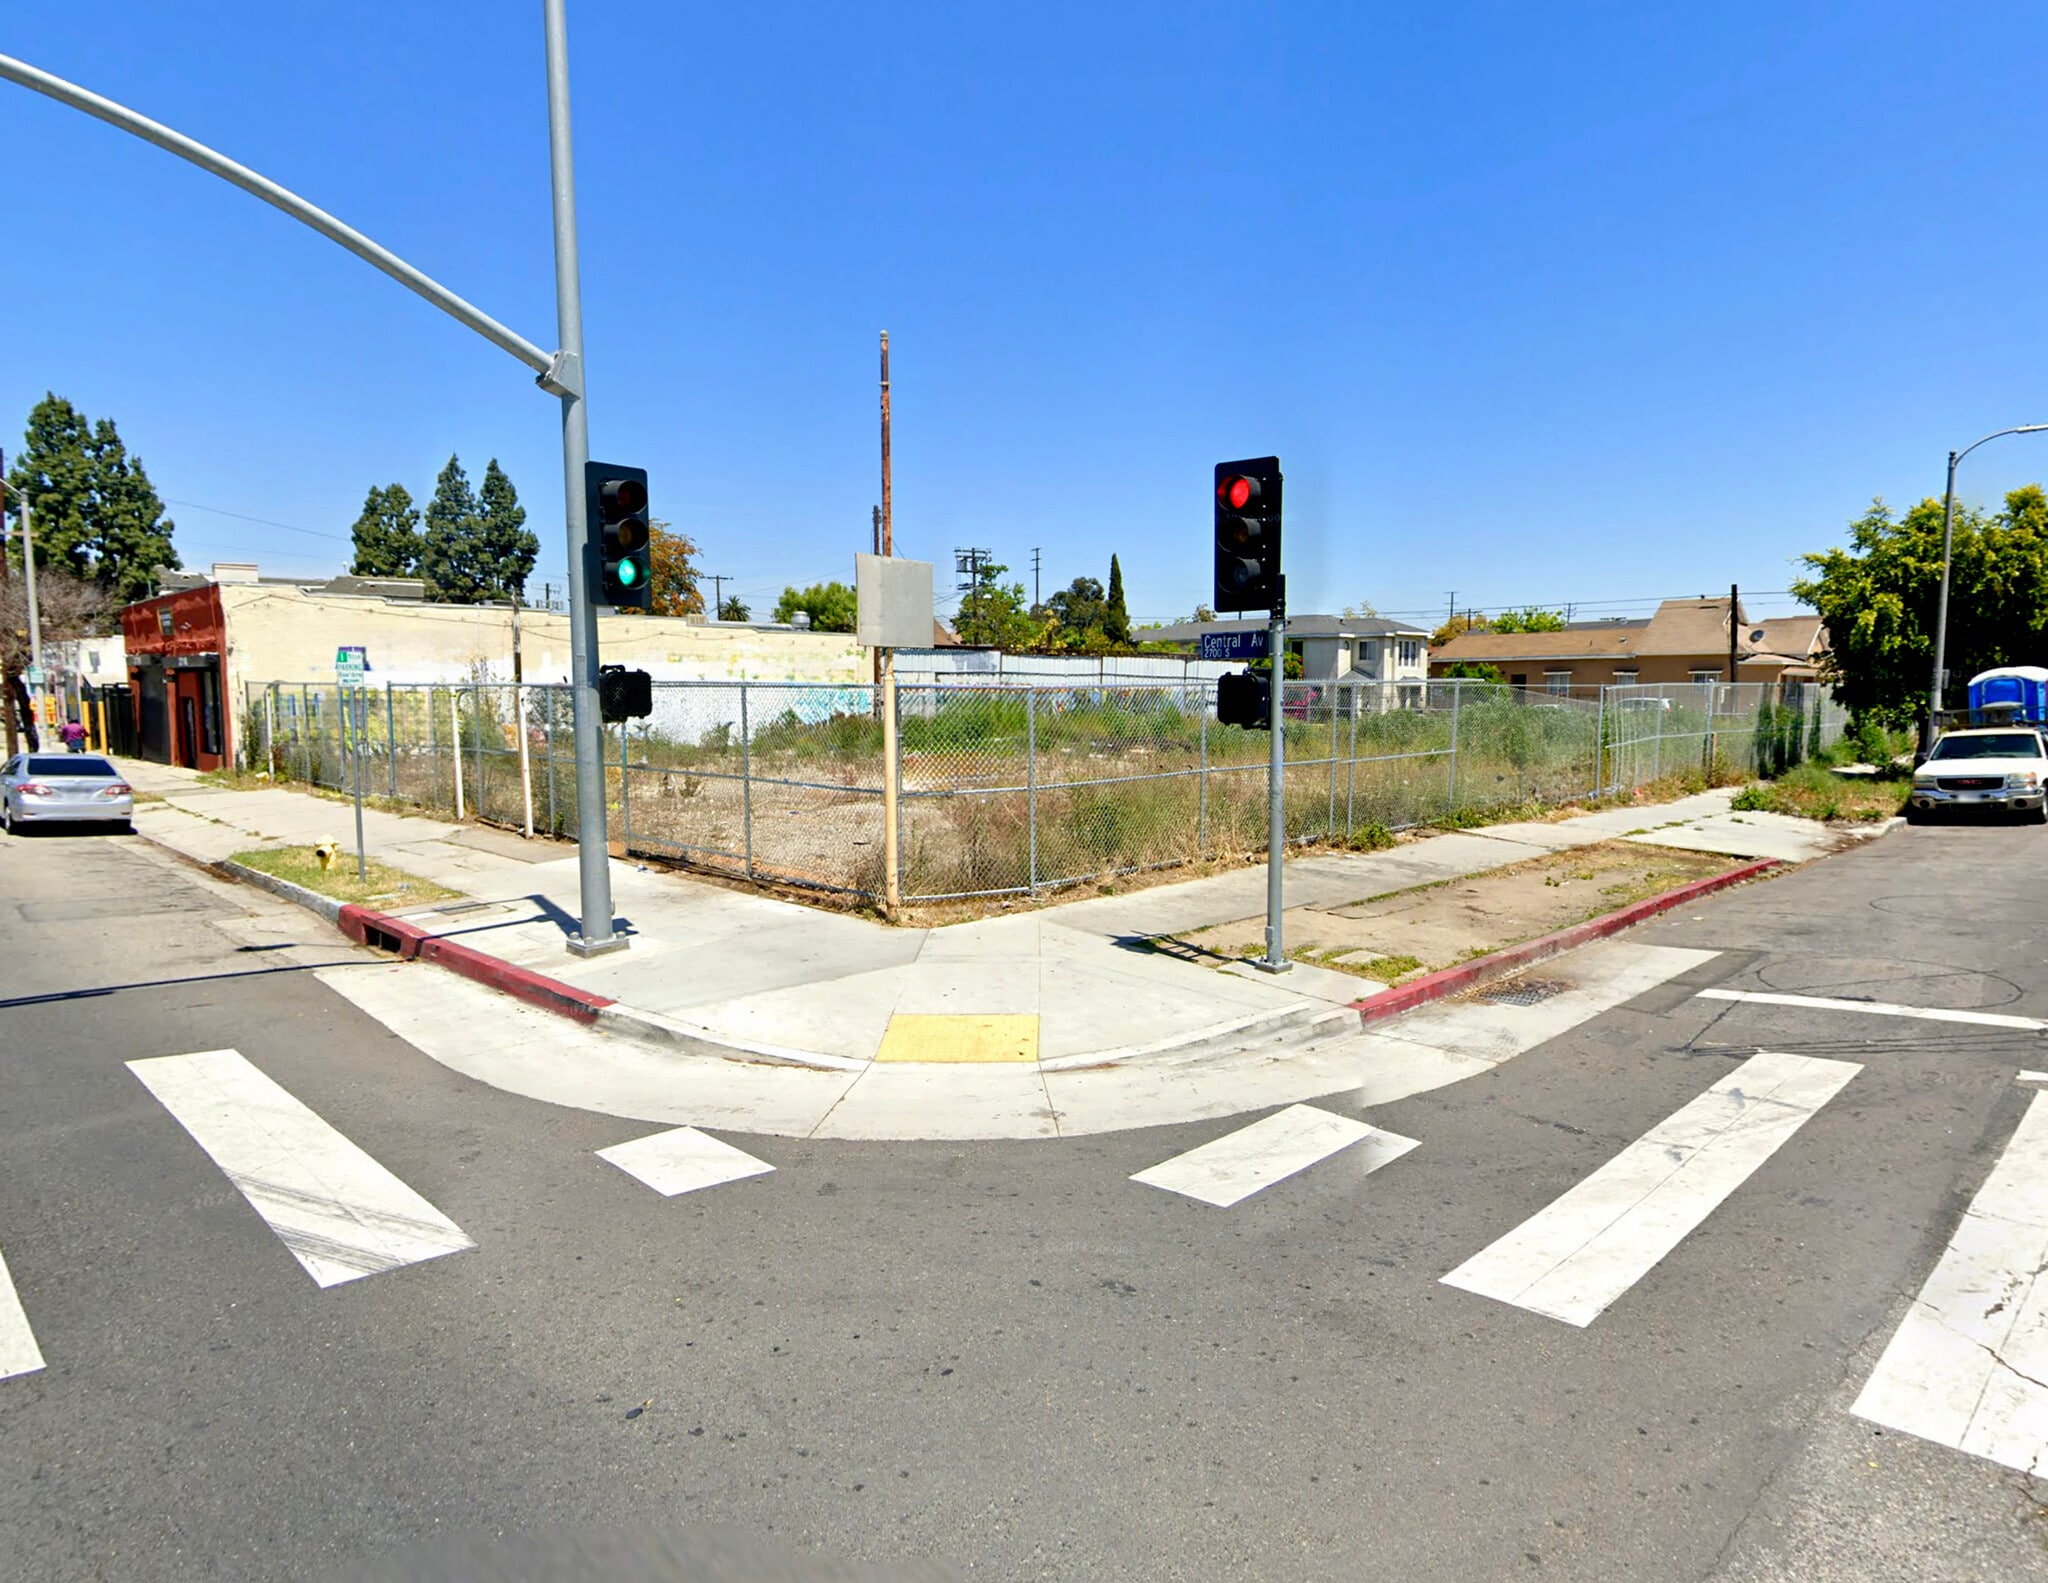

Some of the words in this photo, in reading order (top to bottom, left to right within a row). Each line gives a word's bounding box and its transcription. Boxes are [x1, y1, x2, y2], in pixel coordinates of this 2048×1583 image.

[1204, 634, 1241, 649] Central
[1251, 633, 1264, 648] Av
[1204, 648, 1222, 658] 2700
[1225, 648, 1230, 657] S
